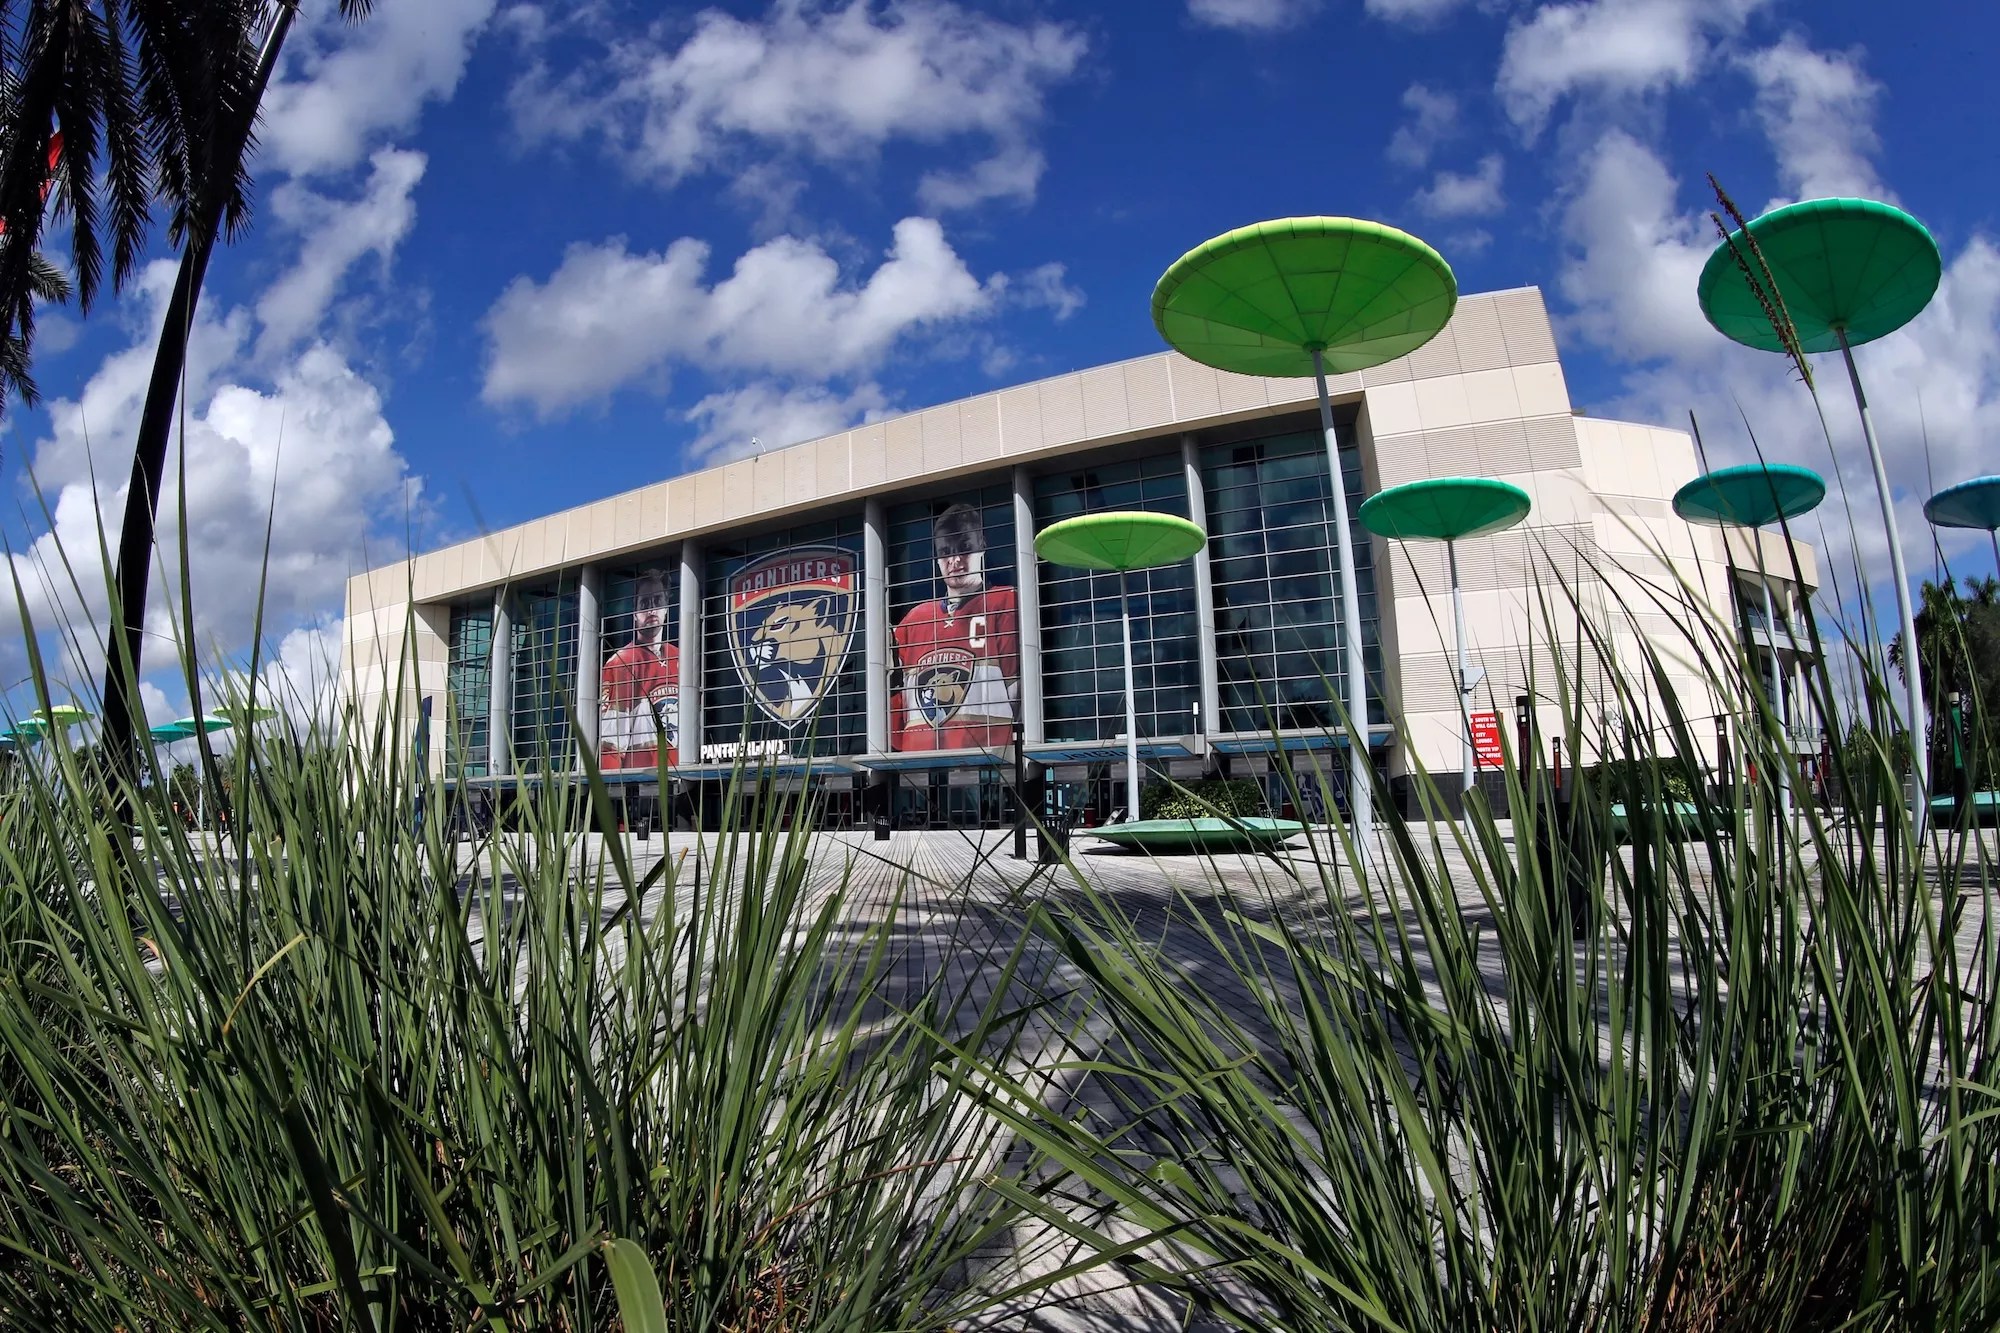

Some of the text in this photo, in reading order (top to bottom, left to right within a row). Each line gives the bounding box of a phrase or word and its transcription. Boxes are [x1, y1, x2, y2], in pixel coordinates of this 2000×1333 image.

[742, 561, 841, 600] PANTHERS
[969, 616, 986, 648] C
[920, 652, 968, 669] PANTHERS
